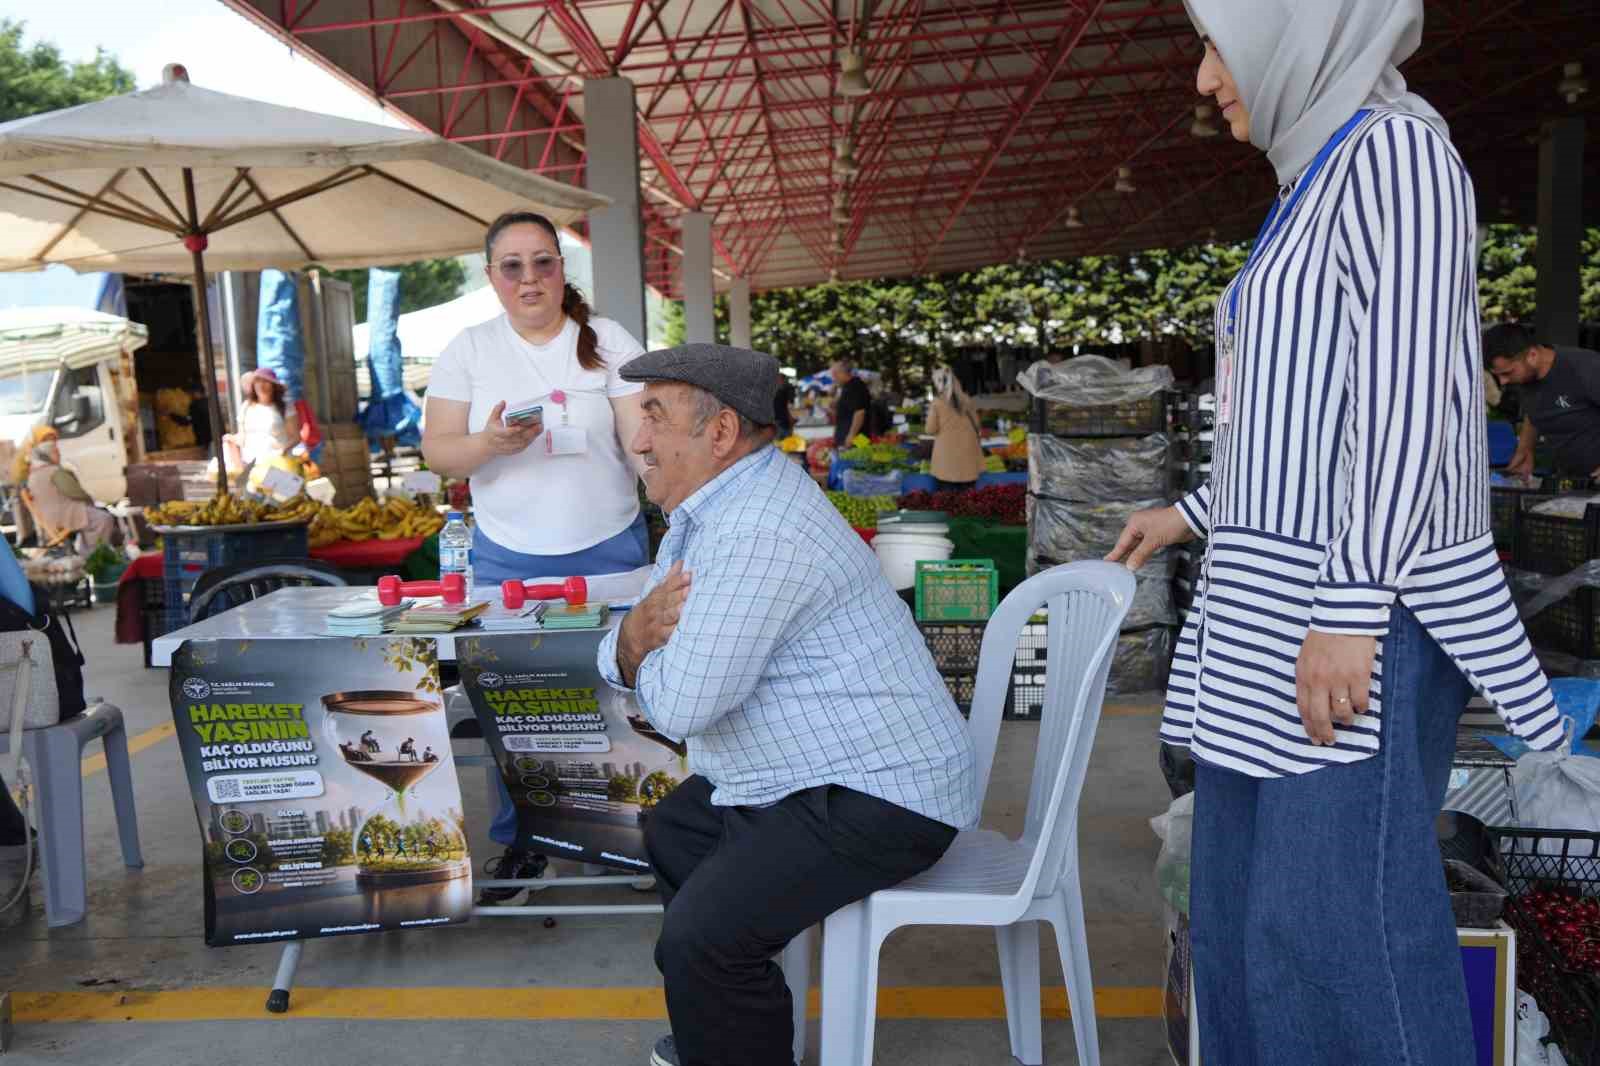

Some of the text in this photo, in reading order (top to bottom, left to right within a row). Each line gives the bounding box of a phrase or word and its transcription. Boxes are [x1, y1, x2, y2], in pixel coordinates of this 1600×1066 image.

[484, 688, 594, 701] HAREKET
[189, 704, 303, 722] HAREKET
[489, 701, 599, 716] YAŞININ
[193, 721, 309, 743] YAŞININ
[200, 740, 313, 758] KAÇ OLDUĞUNU
[202, 754, 318, 772] BİLİYOR MUSUN?
